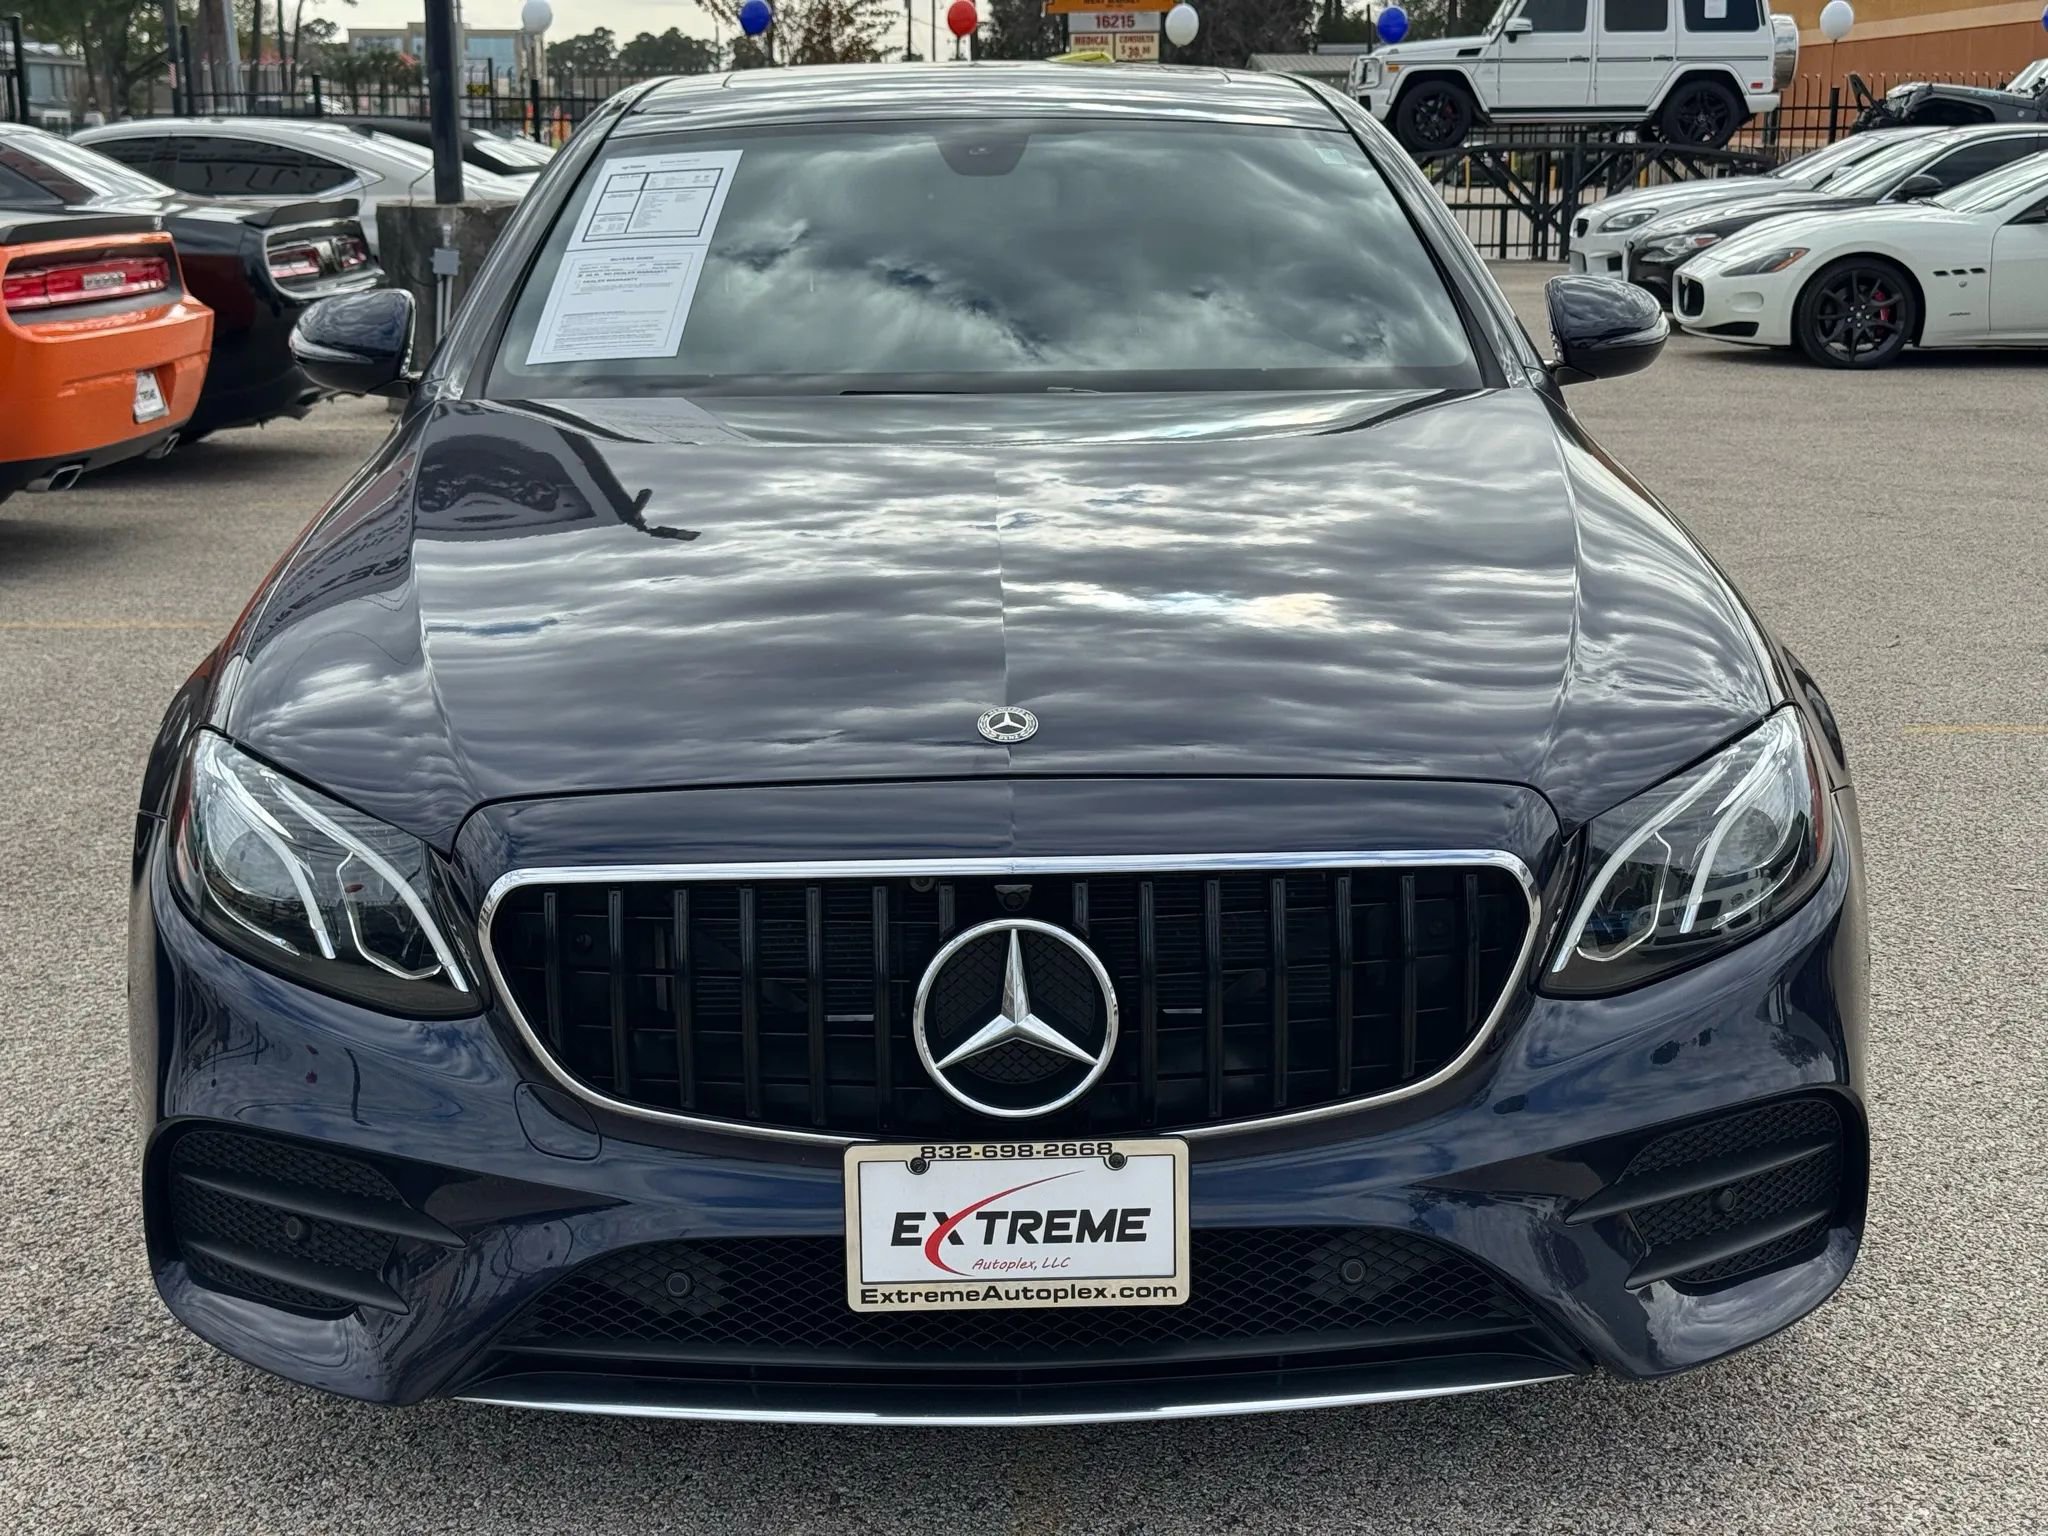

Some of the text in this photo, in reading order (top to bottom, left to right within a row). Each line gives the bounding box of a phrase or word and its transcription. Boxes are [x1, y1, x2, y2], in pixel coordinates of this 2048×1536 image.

[1095, 15, 1135, 29] 16215
[1074, 36, 1109, 45] MEDICAL
[920, 1142, 1113, 1160] 832-698-2668
[890, 1207, 1152, 1247] EXTREME
[971, 1257, 1071, 1273] Autoplex, LLC
[860, 1284, 1177, 1305] ExtremeAutoplex.com
